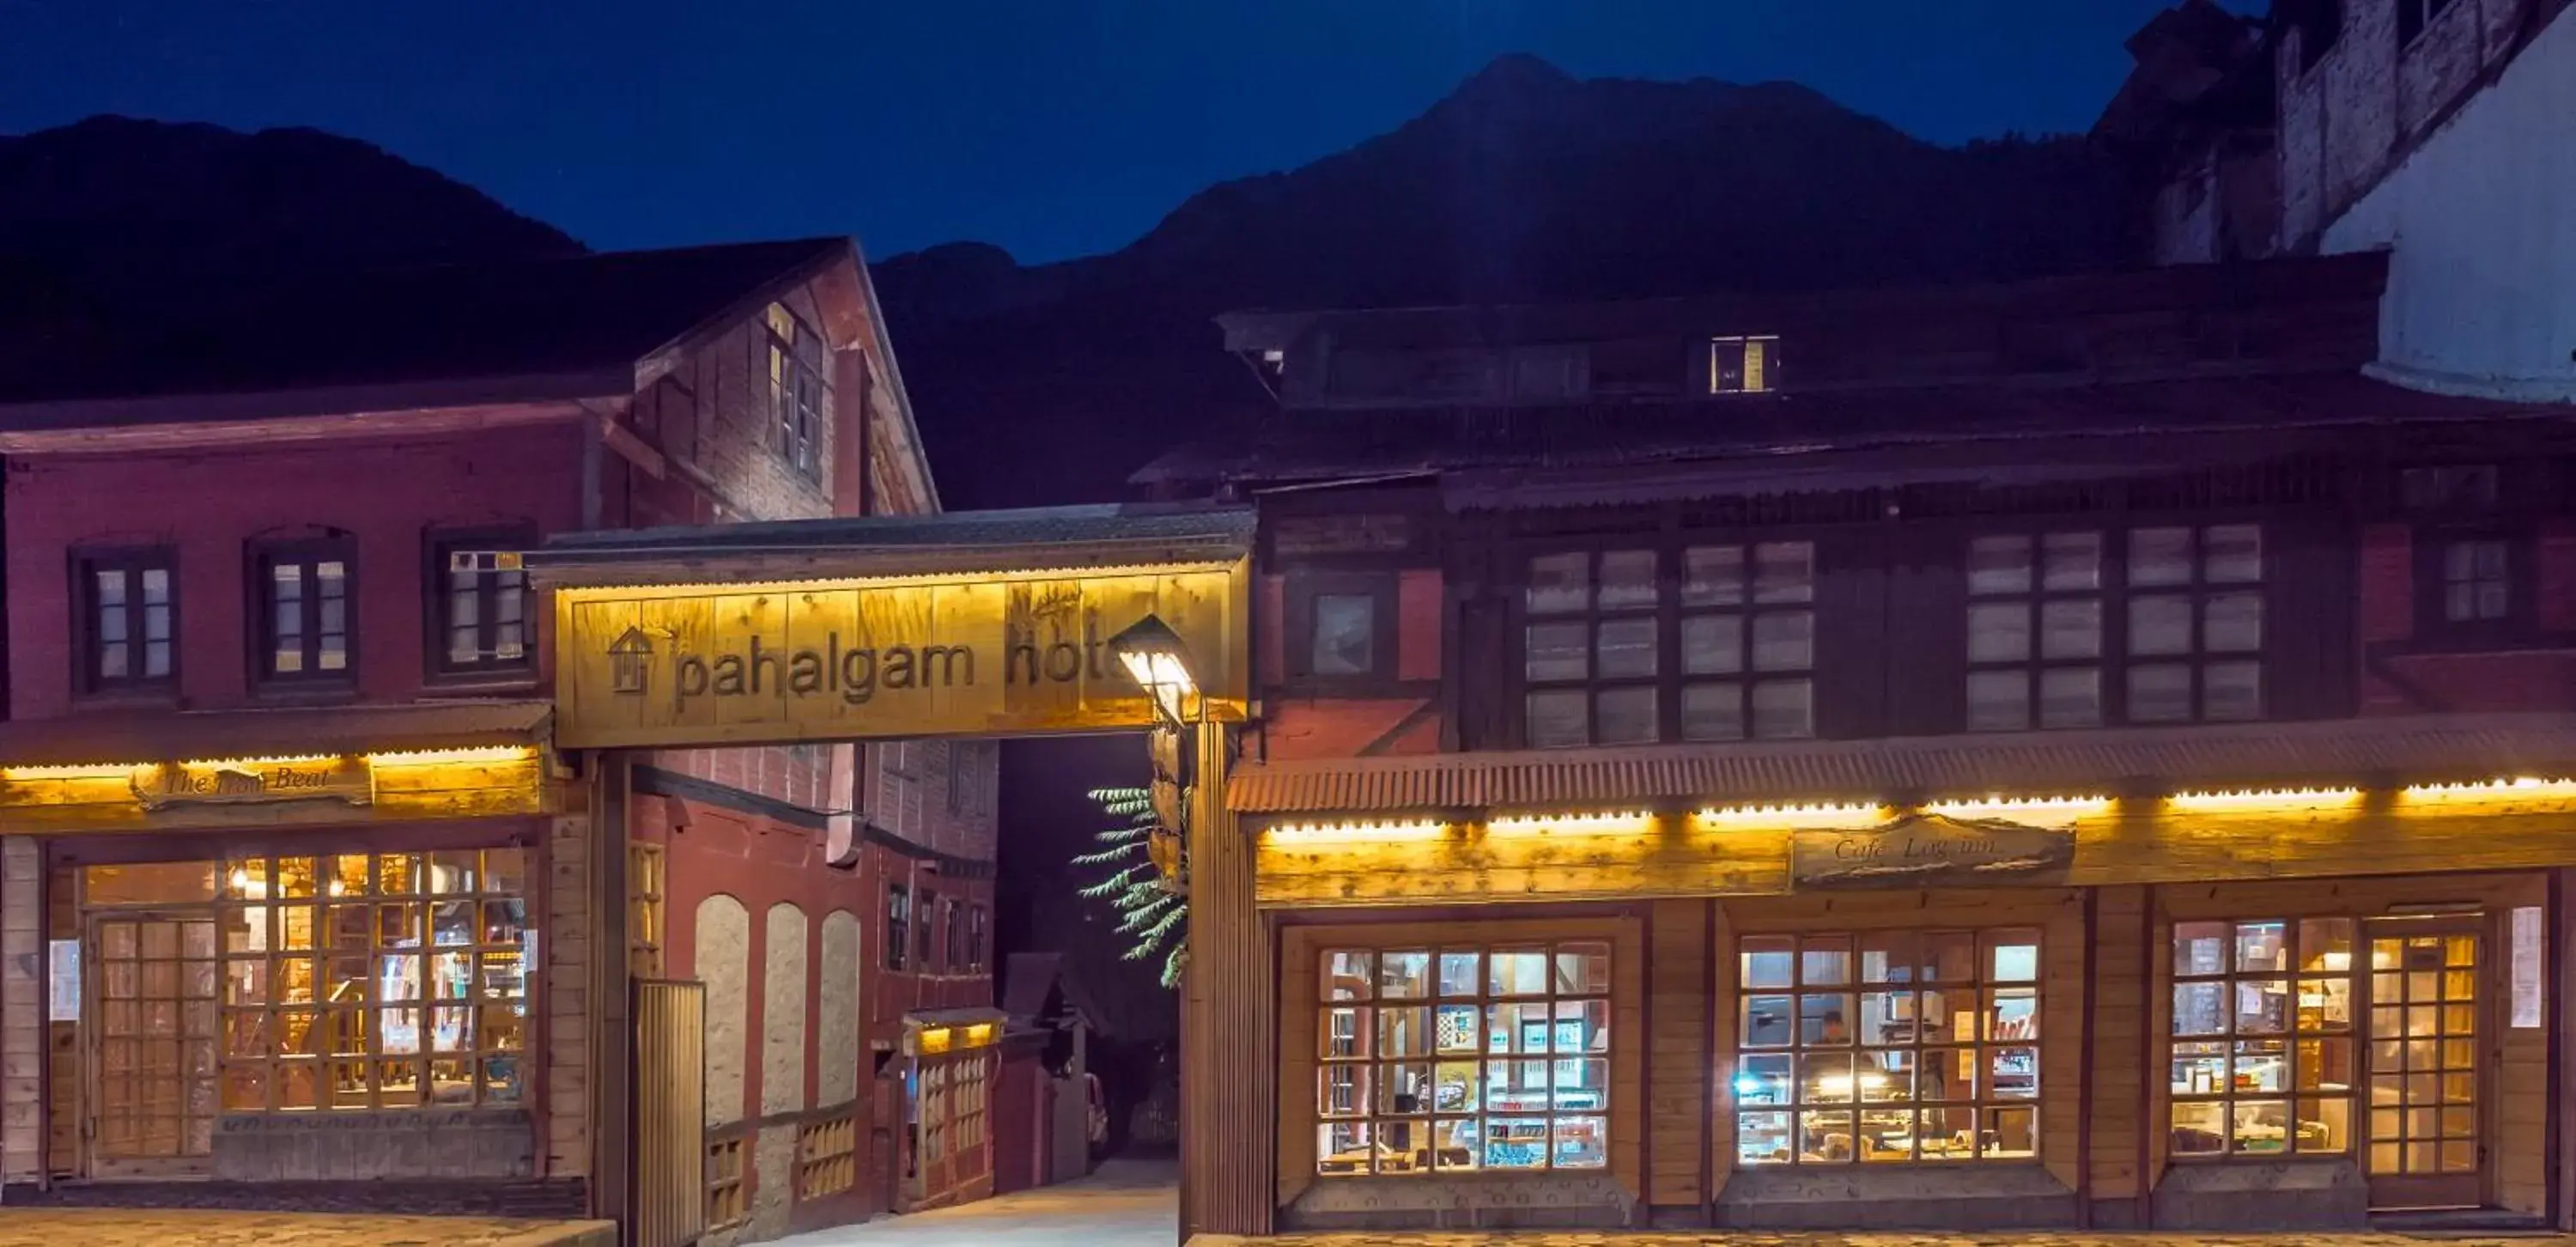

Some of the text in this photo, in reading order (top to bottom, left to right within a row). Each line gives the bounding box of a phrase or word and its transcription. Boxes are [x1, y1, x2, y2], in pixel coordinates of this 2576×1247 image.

[674, 622, 1128, 714] pahalgam hote
[166, 769, 207, 793] The
[275, 767, 329, 788] Beat
